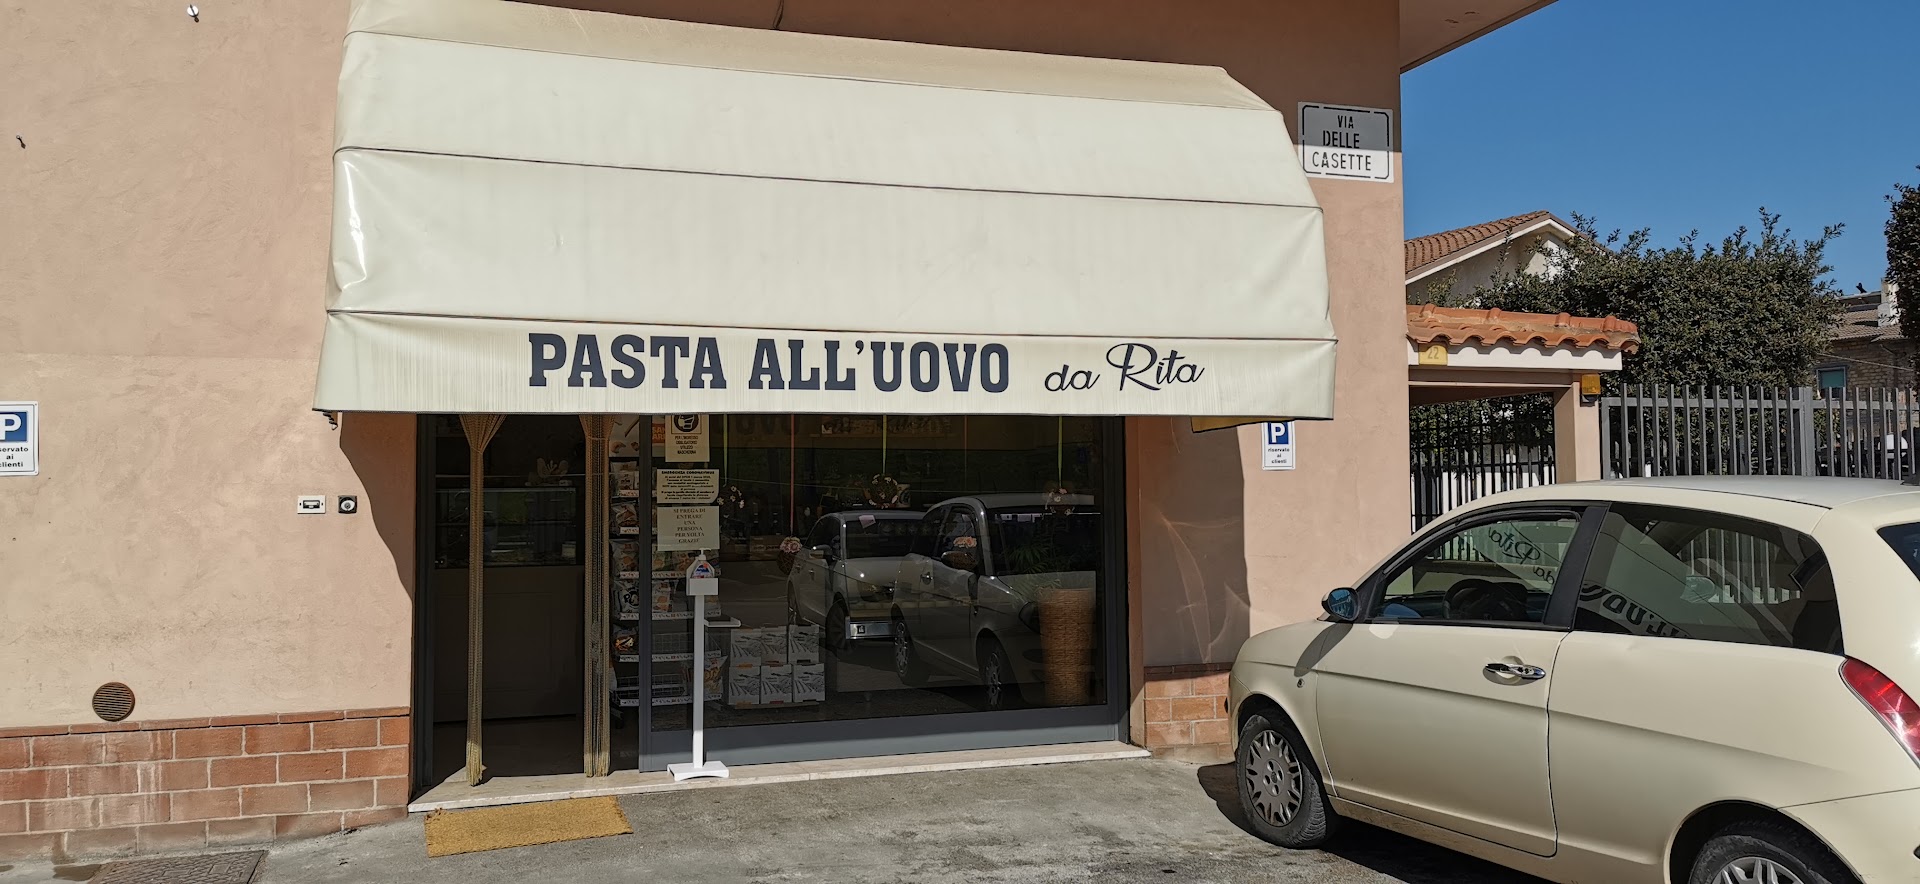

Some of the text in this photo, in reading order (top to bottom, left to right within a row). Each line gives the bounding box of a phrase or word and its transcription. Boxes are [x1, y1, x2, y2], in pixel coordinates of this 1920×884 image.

[1337, 115, 1354, 129] VIA
[1323, 130, 1360, 149] DELLE
[1312, 151, 1371, 171] CASETTE
[529, 333, 1205, 393] PASTA ALL'UOVO da Rita
[1427, 346, 1439, 360] 22
[0, 413, 22, 440] P
[1271, 422, 1286, 443] P
